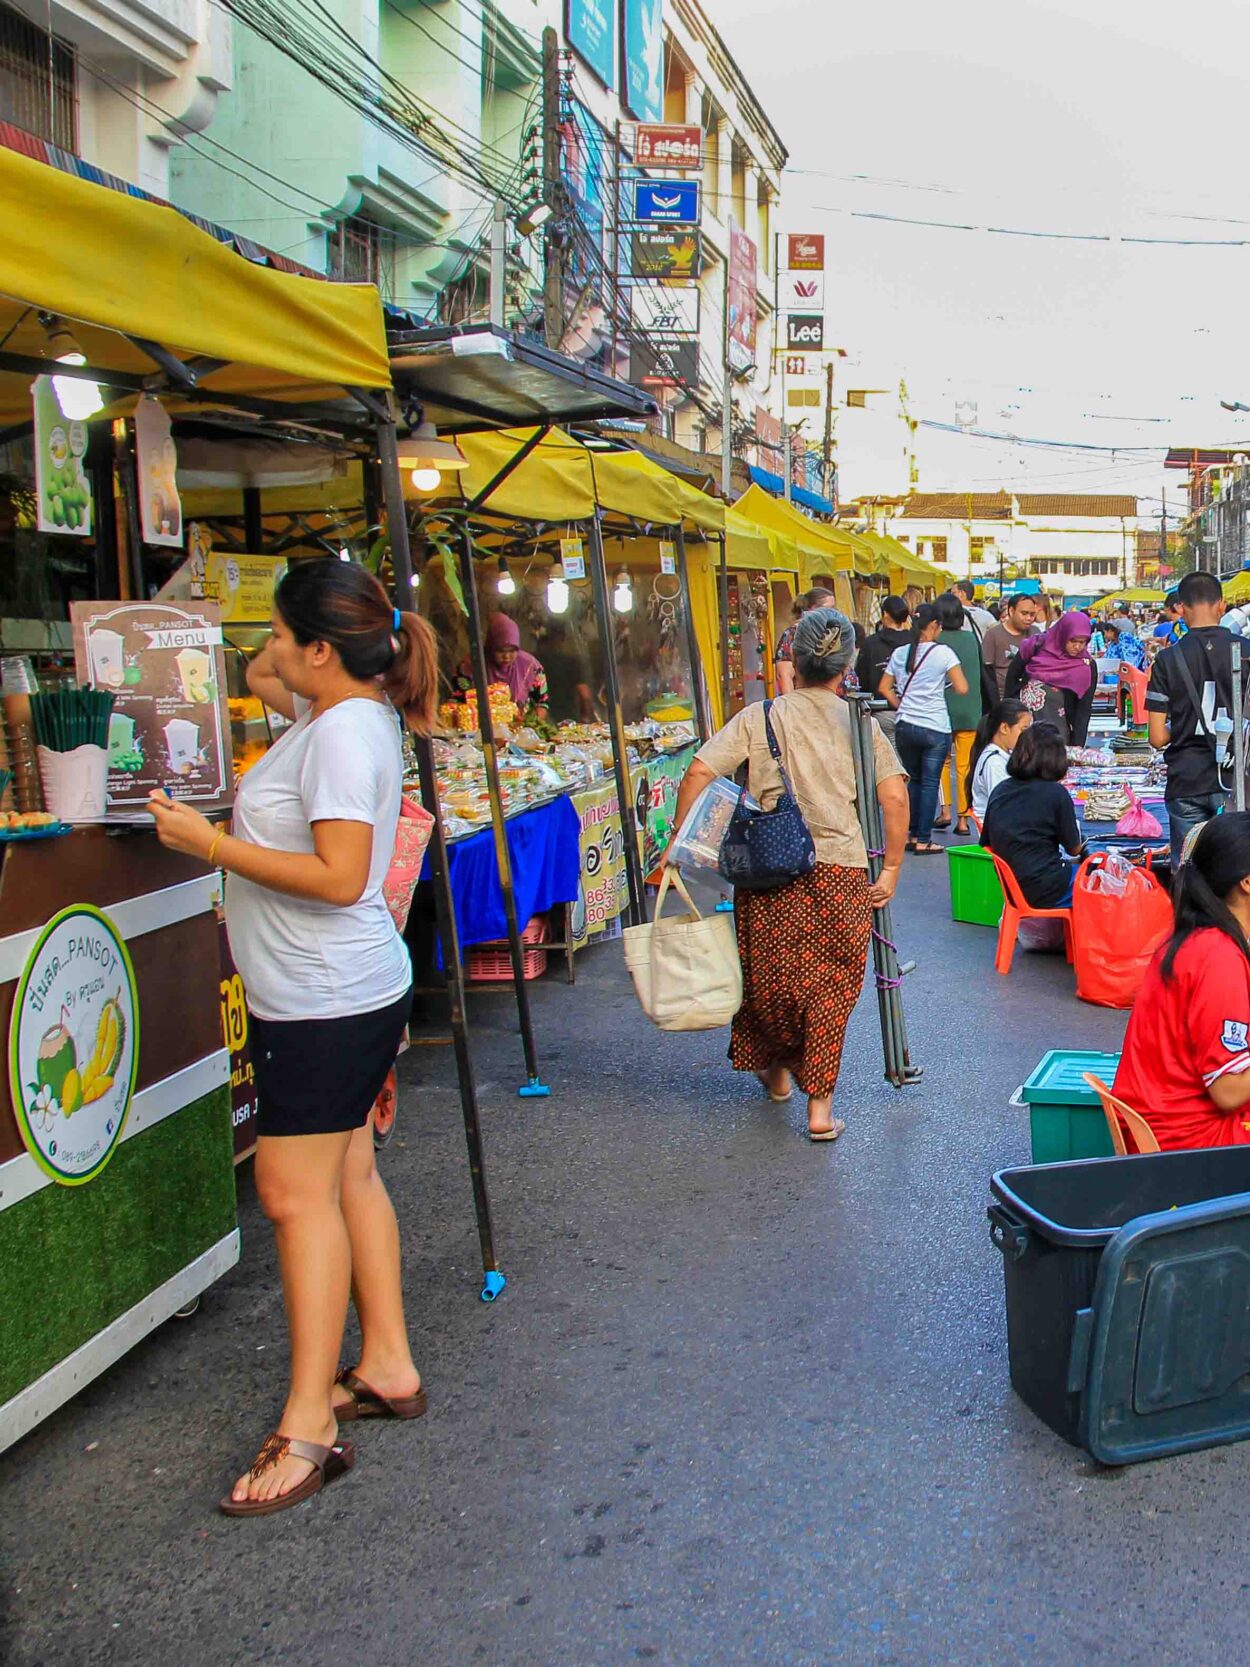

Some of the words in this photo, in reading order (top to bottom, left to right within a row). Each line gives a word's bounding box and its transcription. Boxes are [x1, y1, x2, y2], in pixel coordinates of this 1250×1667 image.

[789, 323, 821, 342] Lee
[158, 633, 206, 647] Menu
[65, 991, 76, 1008] By
